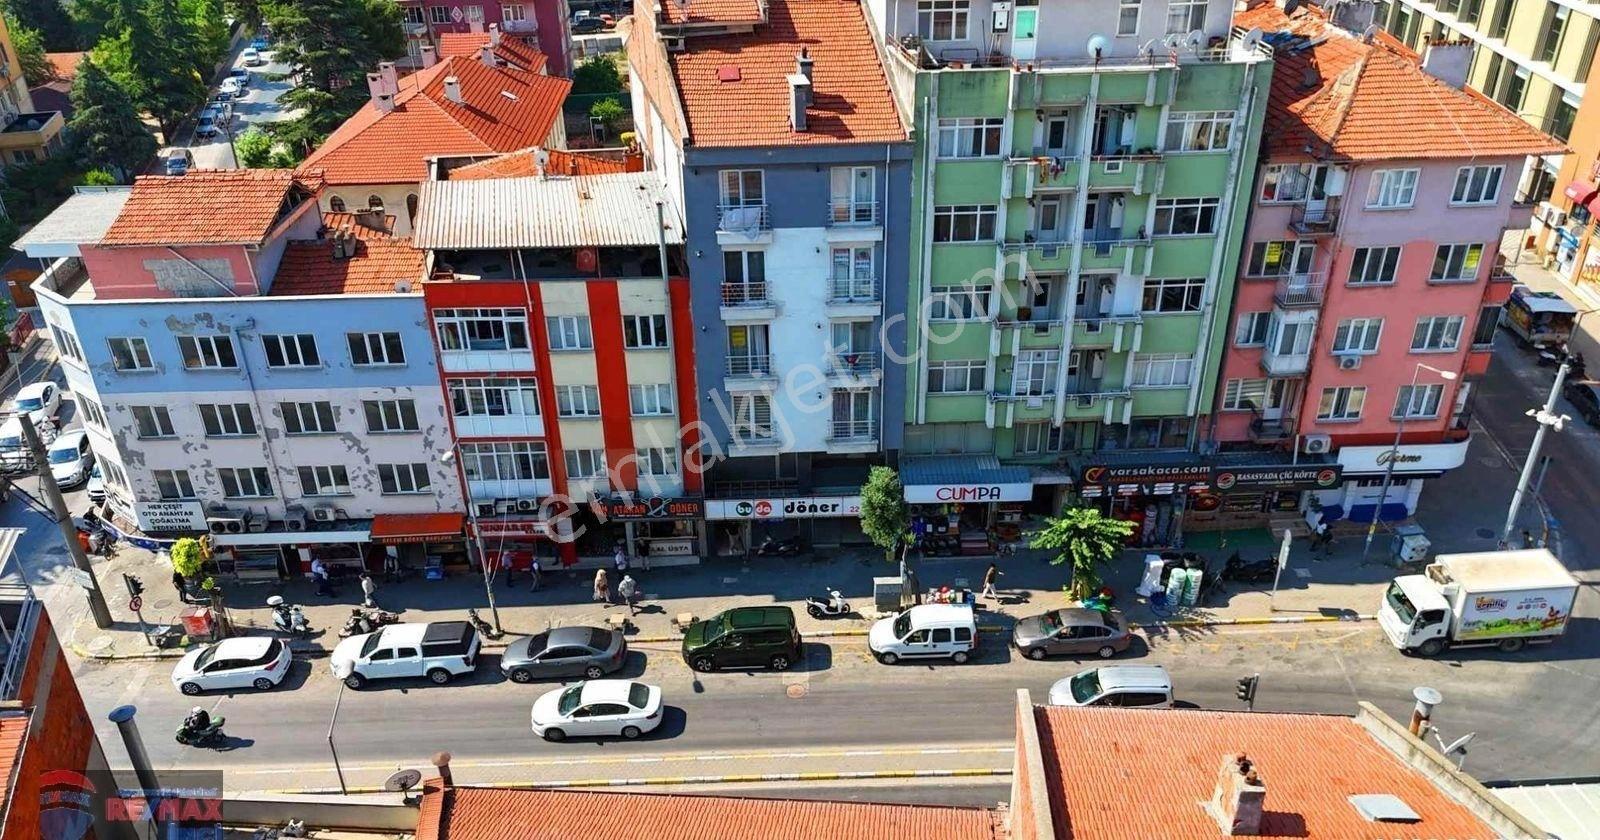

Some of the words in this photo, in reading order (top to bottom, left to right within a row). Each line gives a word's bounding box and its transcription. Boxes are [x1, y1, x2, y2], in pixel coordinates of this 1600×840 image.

[1109, 466, 1211, 476] varsakaca.com
[1279, 470, 1293, 482] ÇİĞ
[1294, 471, 1318, 479] KÖFTE
[936, 487, 1001, 501] CUMPA
[163, 502, 183, 511] ÇEŞİT
[785, 501, 840, 514] döner
[150, 517, 191, 525] ÇOĞALTMA
